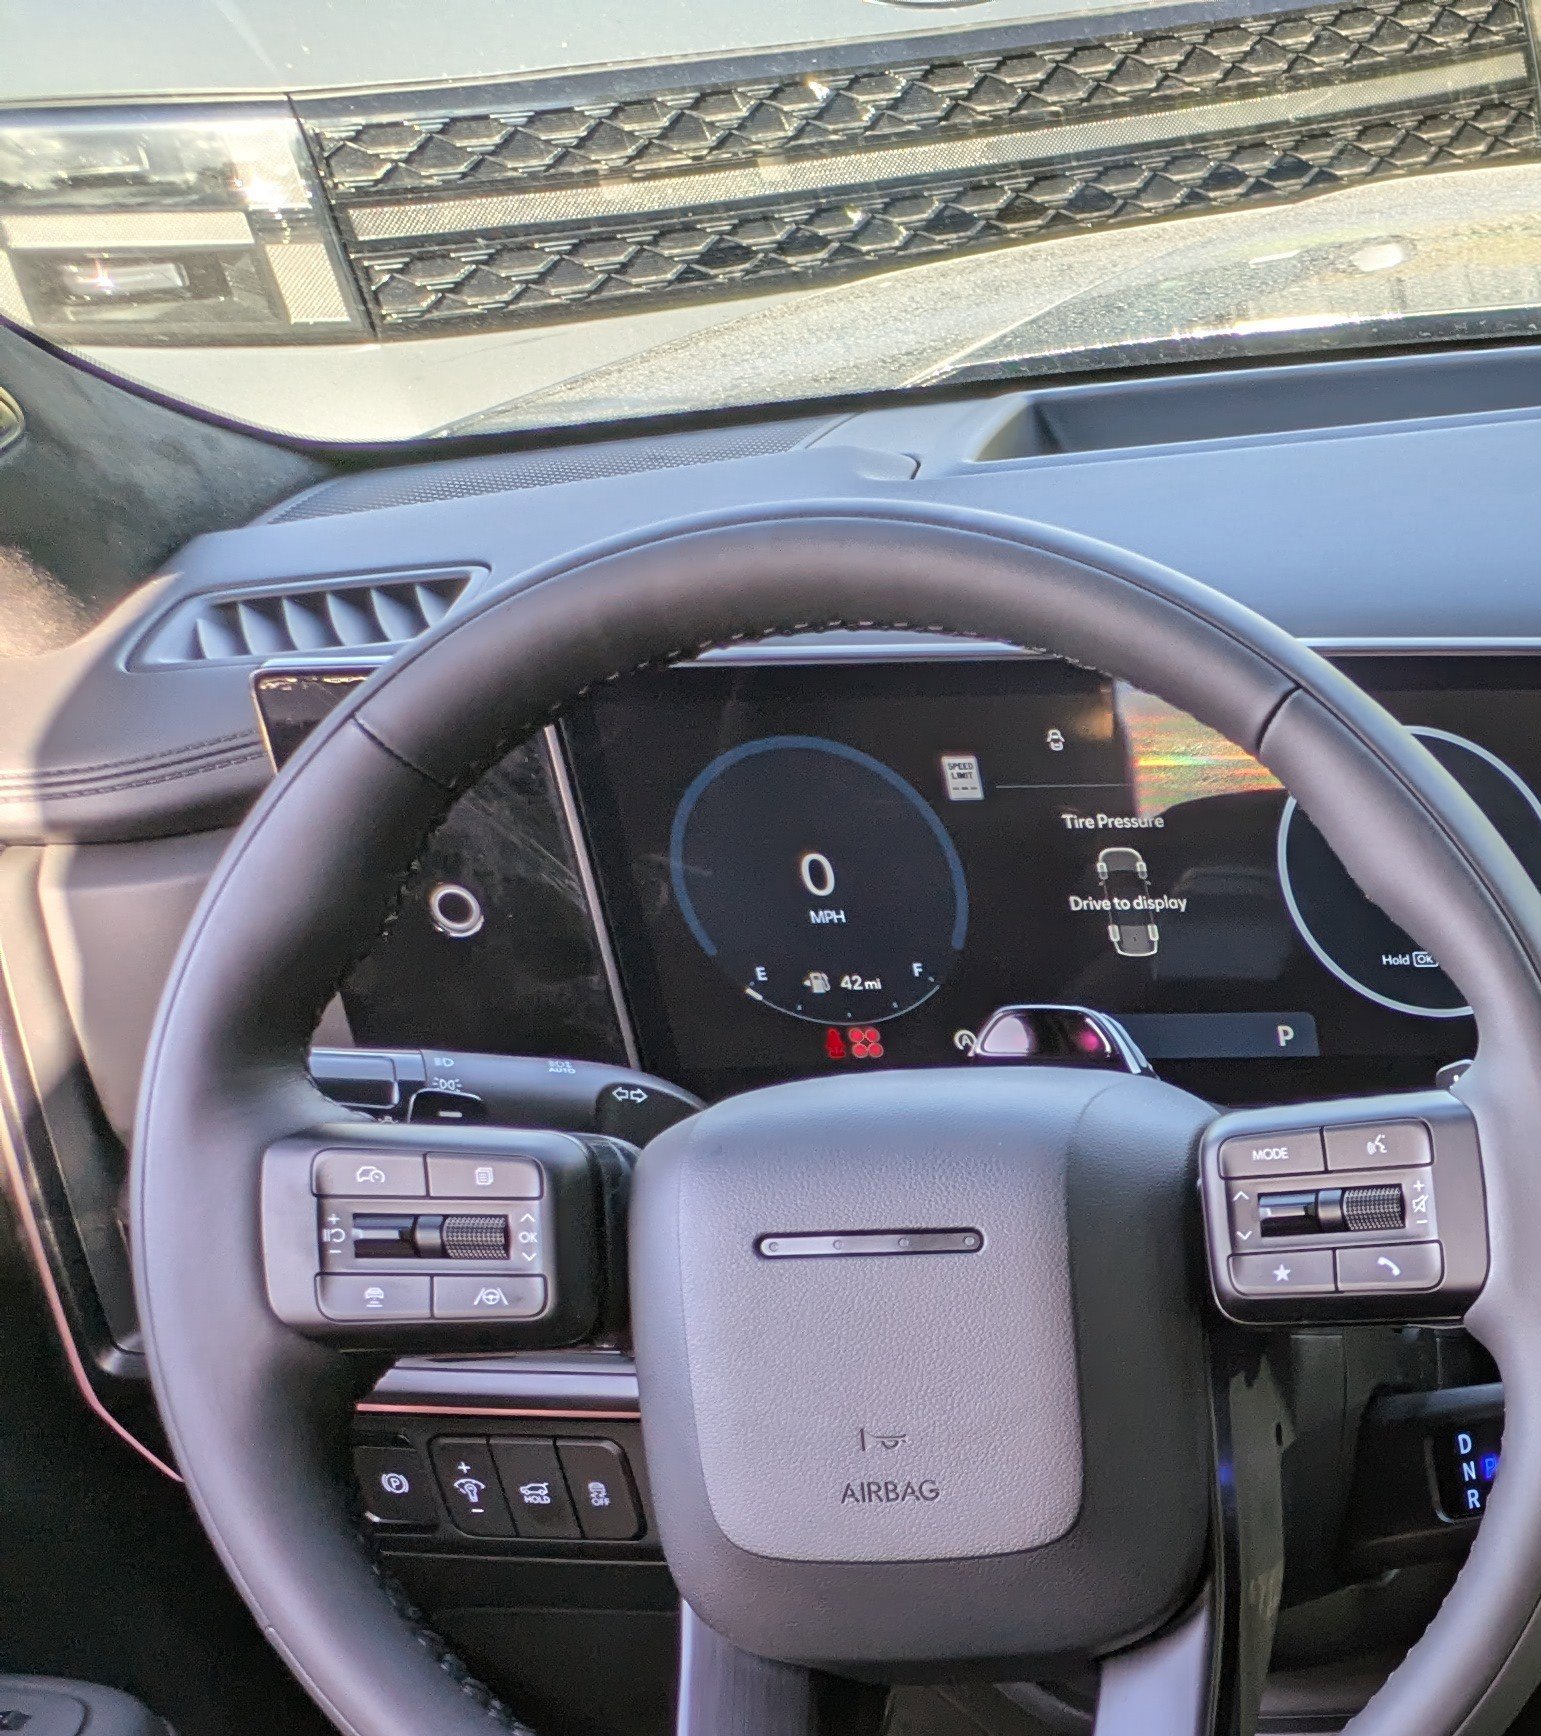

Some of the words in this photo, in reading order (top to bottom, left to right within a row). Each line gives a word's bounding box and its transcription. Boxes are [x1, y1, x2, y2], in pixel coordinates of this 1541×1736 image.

[1061, 813, 1095, 829] Tire
[1096, 813, 1165, 829] Pressure
[801, 853, 835, 897] 0
[1069, 895, 1111, 911] Drive
[1113, 897, 1131, 910] to
[1133, 894, 1187, 912] display
[810, 910, 846, 924] MPH
[1382, 954, 1410, 965] Hold
[755, 967, 768, 981] E
[912, 962, 923, 977] F
[1277, 1025, 1294, 1046] P
[1252, 1147, 1289, 1160] MODE
[519, 1231, 538, 1243] OK
[1457, 1433, 1472, 1455] D
[1462, 1461, 1477, 1482] N
[1484, 1458, 1497, 1479] P
[524, 1496, 550, 1504] HOLD
[841, 1480, 940, 1504] AIRBAG
[1467, 1489, 1480, 1509] R
